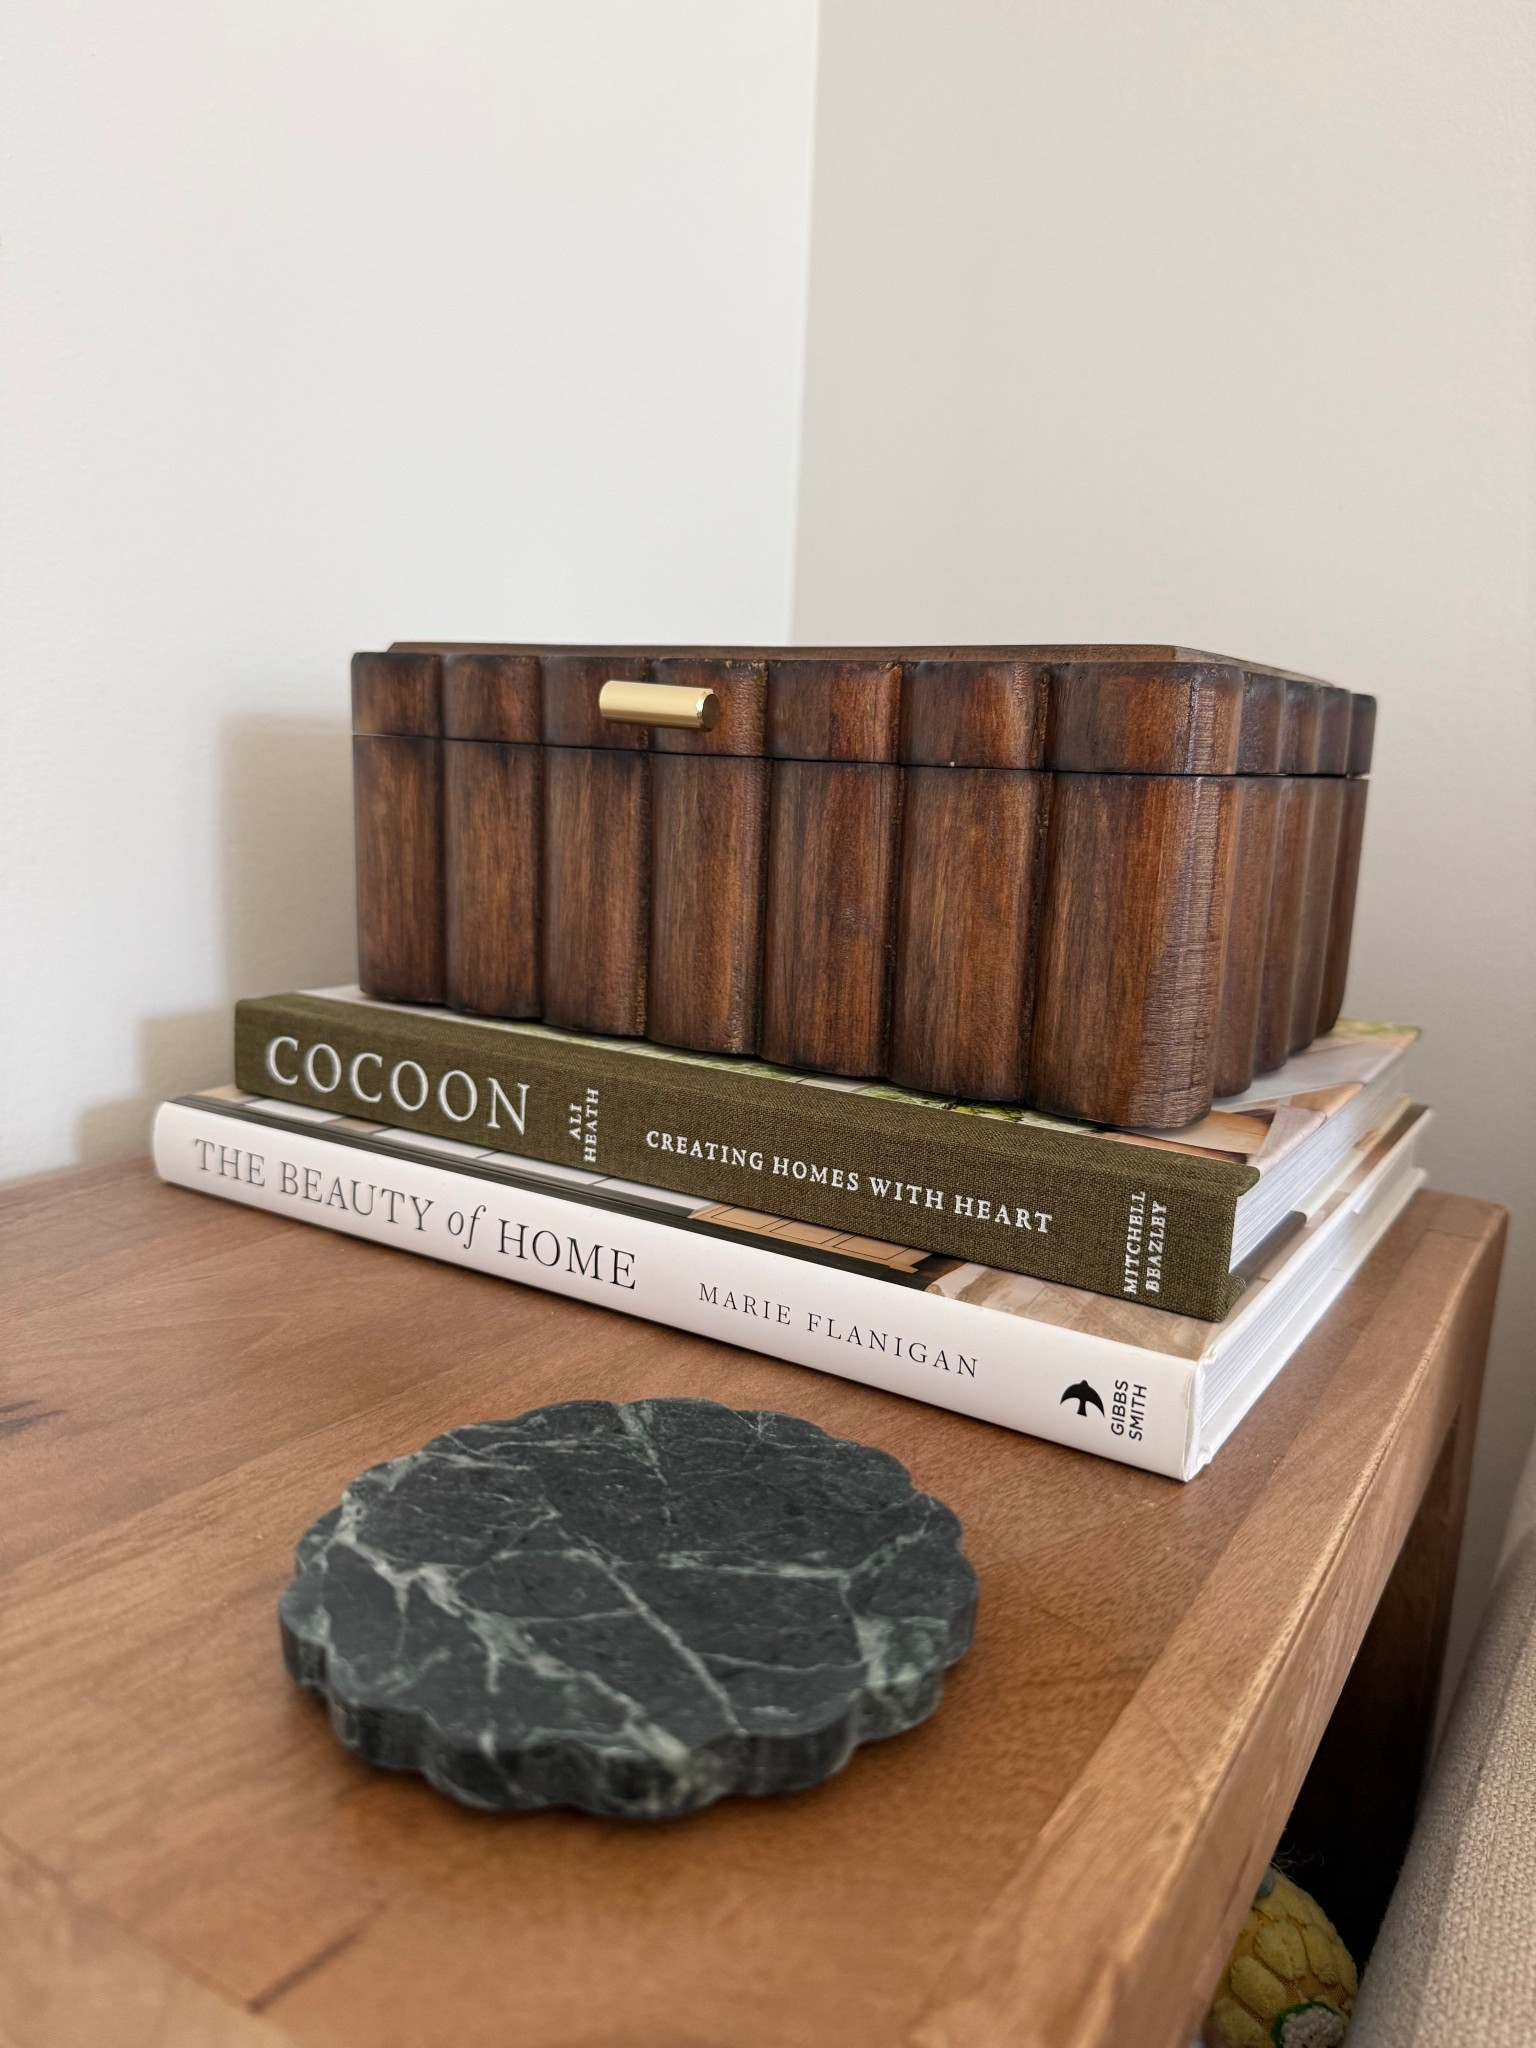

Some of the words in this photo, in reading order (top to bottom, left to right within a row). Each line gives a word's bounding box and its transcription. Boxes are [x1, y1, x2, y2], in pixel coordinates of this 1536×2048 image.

[266, 1035, 530, 1136] COCOON
[568, 1101, 585, 1140] ALI
[583, 1087, 600, 1163] HEATH
[194, 1138, 266, 1188] THE
[280, 1161, 435, 1233] BEAUTY
[447, 1203, 487, 1250] of
[497, 1219, 637, 1291] HOME
[645, 1130, 765, 1172] CREATING
[771, 1155, 861, 1193] HOMES
[868, 1176, 945, 1211] WITH
[954, 1194, 1054, 1234] HEART
[1124, 1190, 1147, 1296] MITCHELL
[1144, 1200, 1168, 1293] BEAZLEY
[699, 1282, 792, 1327] MARIE
[806, 1312, 979, 1380] FLANIGAN
[1110, 1379, 1130, 1437] GIBBS
[1129, 1383, 1149, 1442] SMITH
